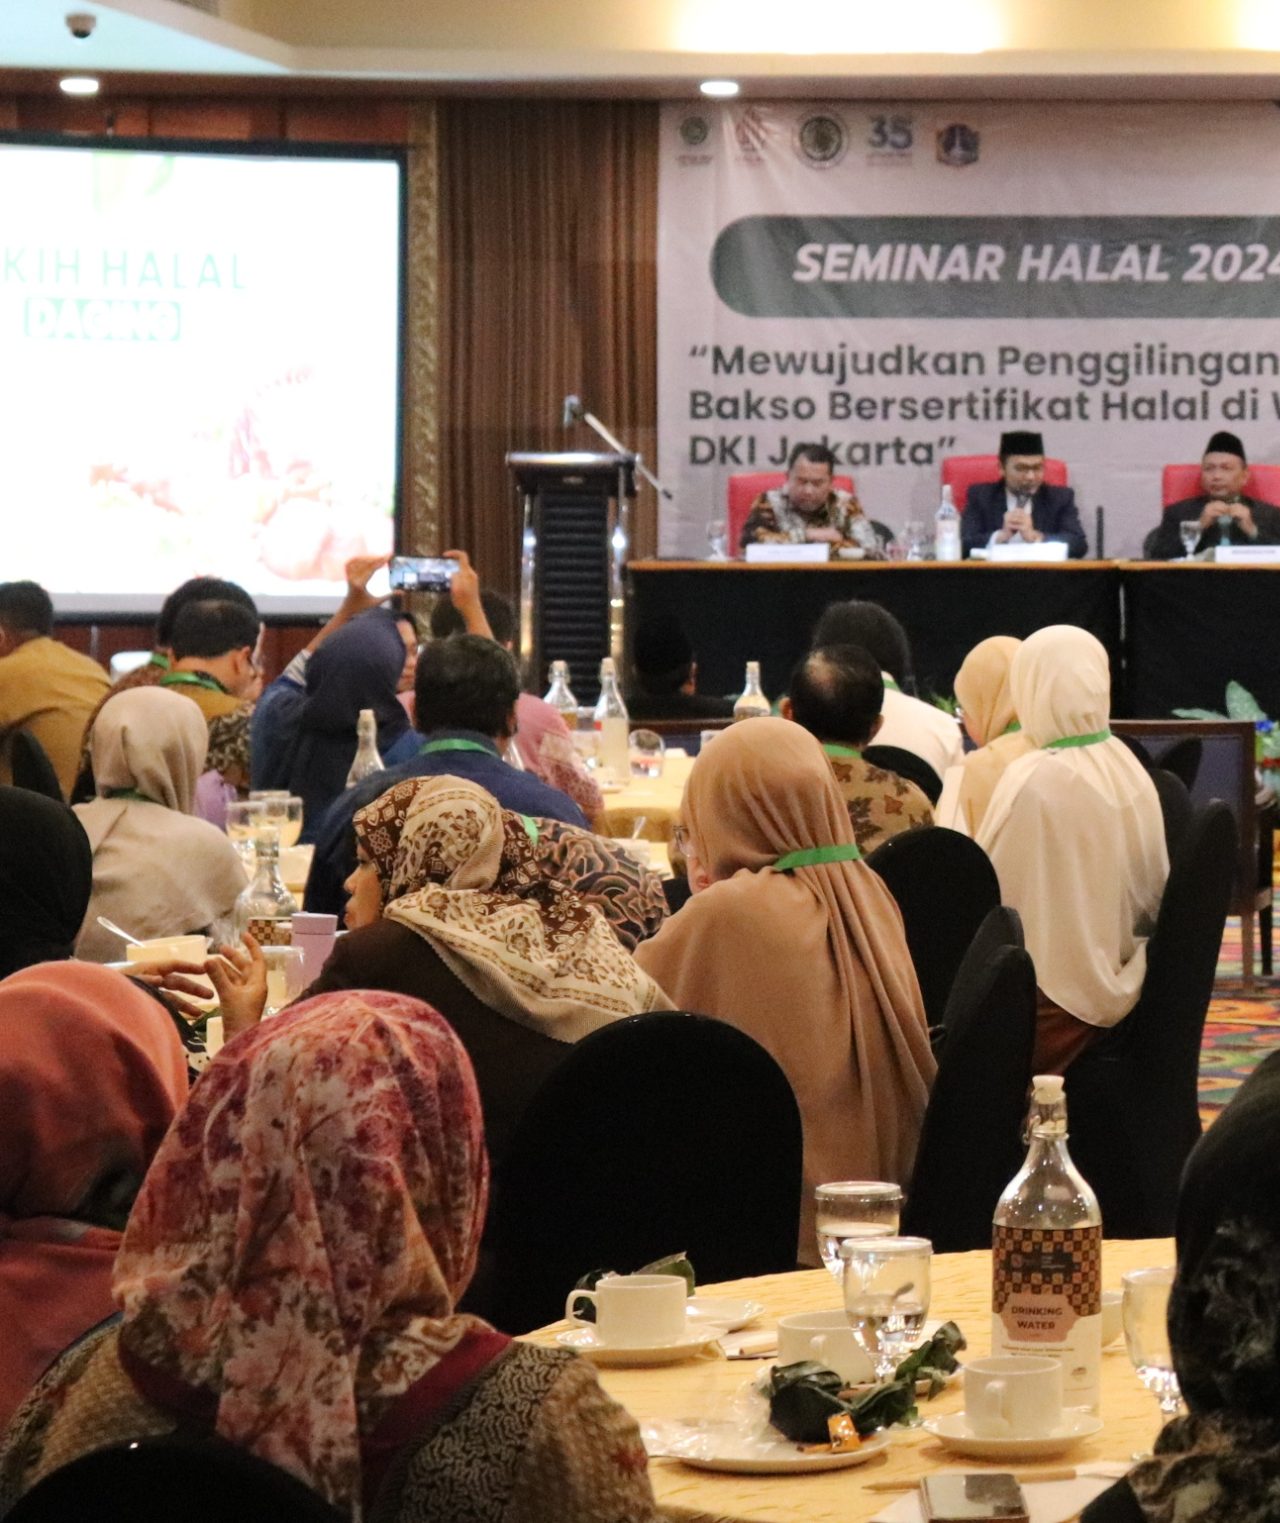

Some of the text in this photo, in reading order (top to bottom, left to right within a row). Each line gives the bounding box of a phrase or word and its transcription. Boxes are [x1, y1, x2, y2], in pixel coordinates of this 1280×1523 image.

[869, 115, 912, 149] 35
[102, 250, 247, 289] HALAL
[793, 242, 1003, 283] SEMINAR
[1017, 242, 1170, 283] HALAL
[28, 299, 178, 340] DAGING
[999, 342, 1280, 387] Penggilingan
[689, 388, 816, 421] Bakso
[829, 387, 1090, 421] Bersertifikat
[1102, 388, 1210, 421] Halal
[1221, 387, 1259, 421] di
[689, 434, 956, 466] DKI Jkarta”
[1011, 1306, 1063, 1316] DRINKING
[1017, 1320, 1055, 1330] WATER
